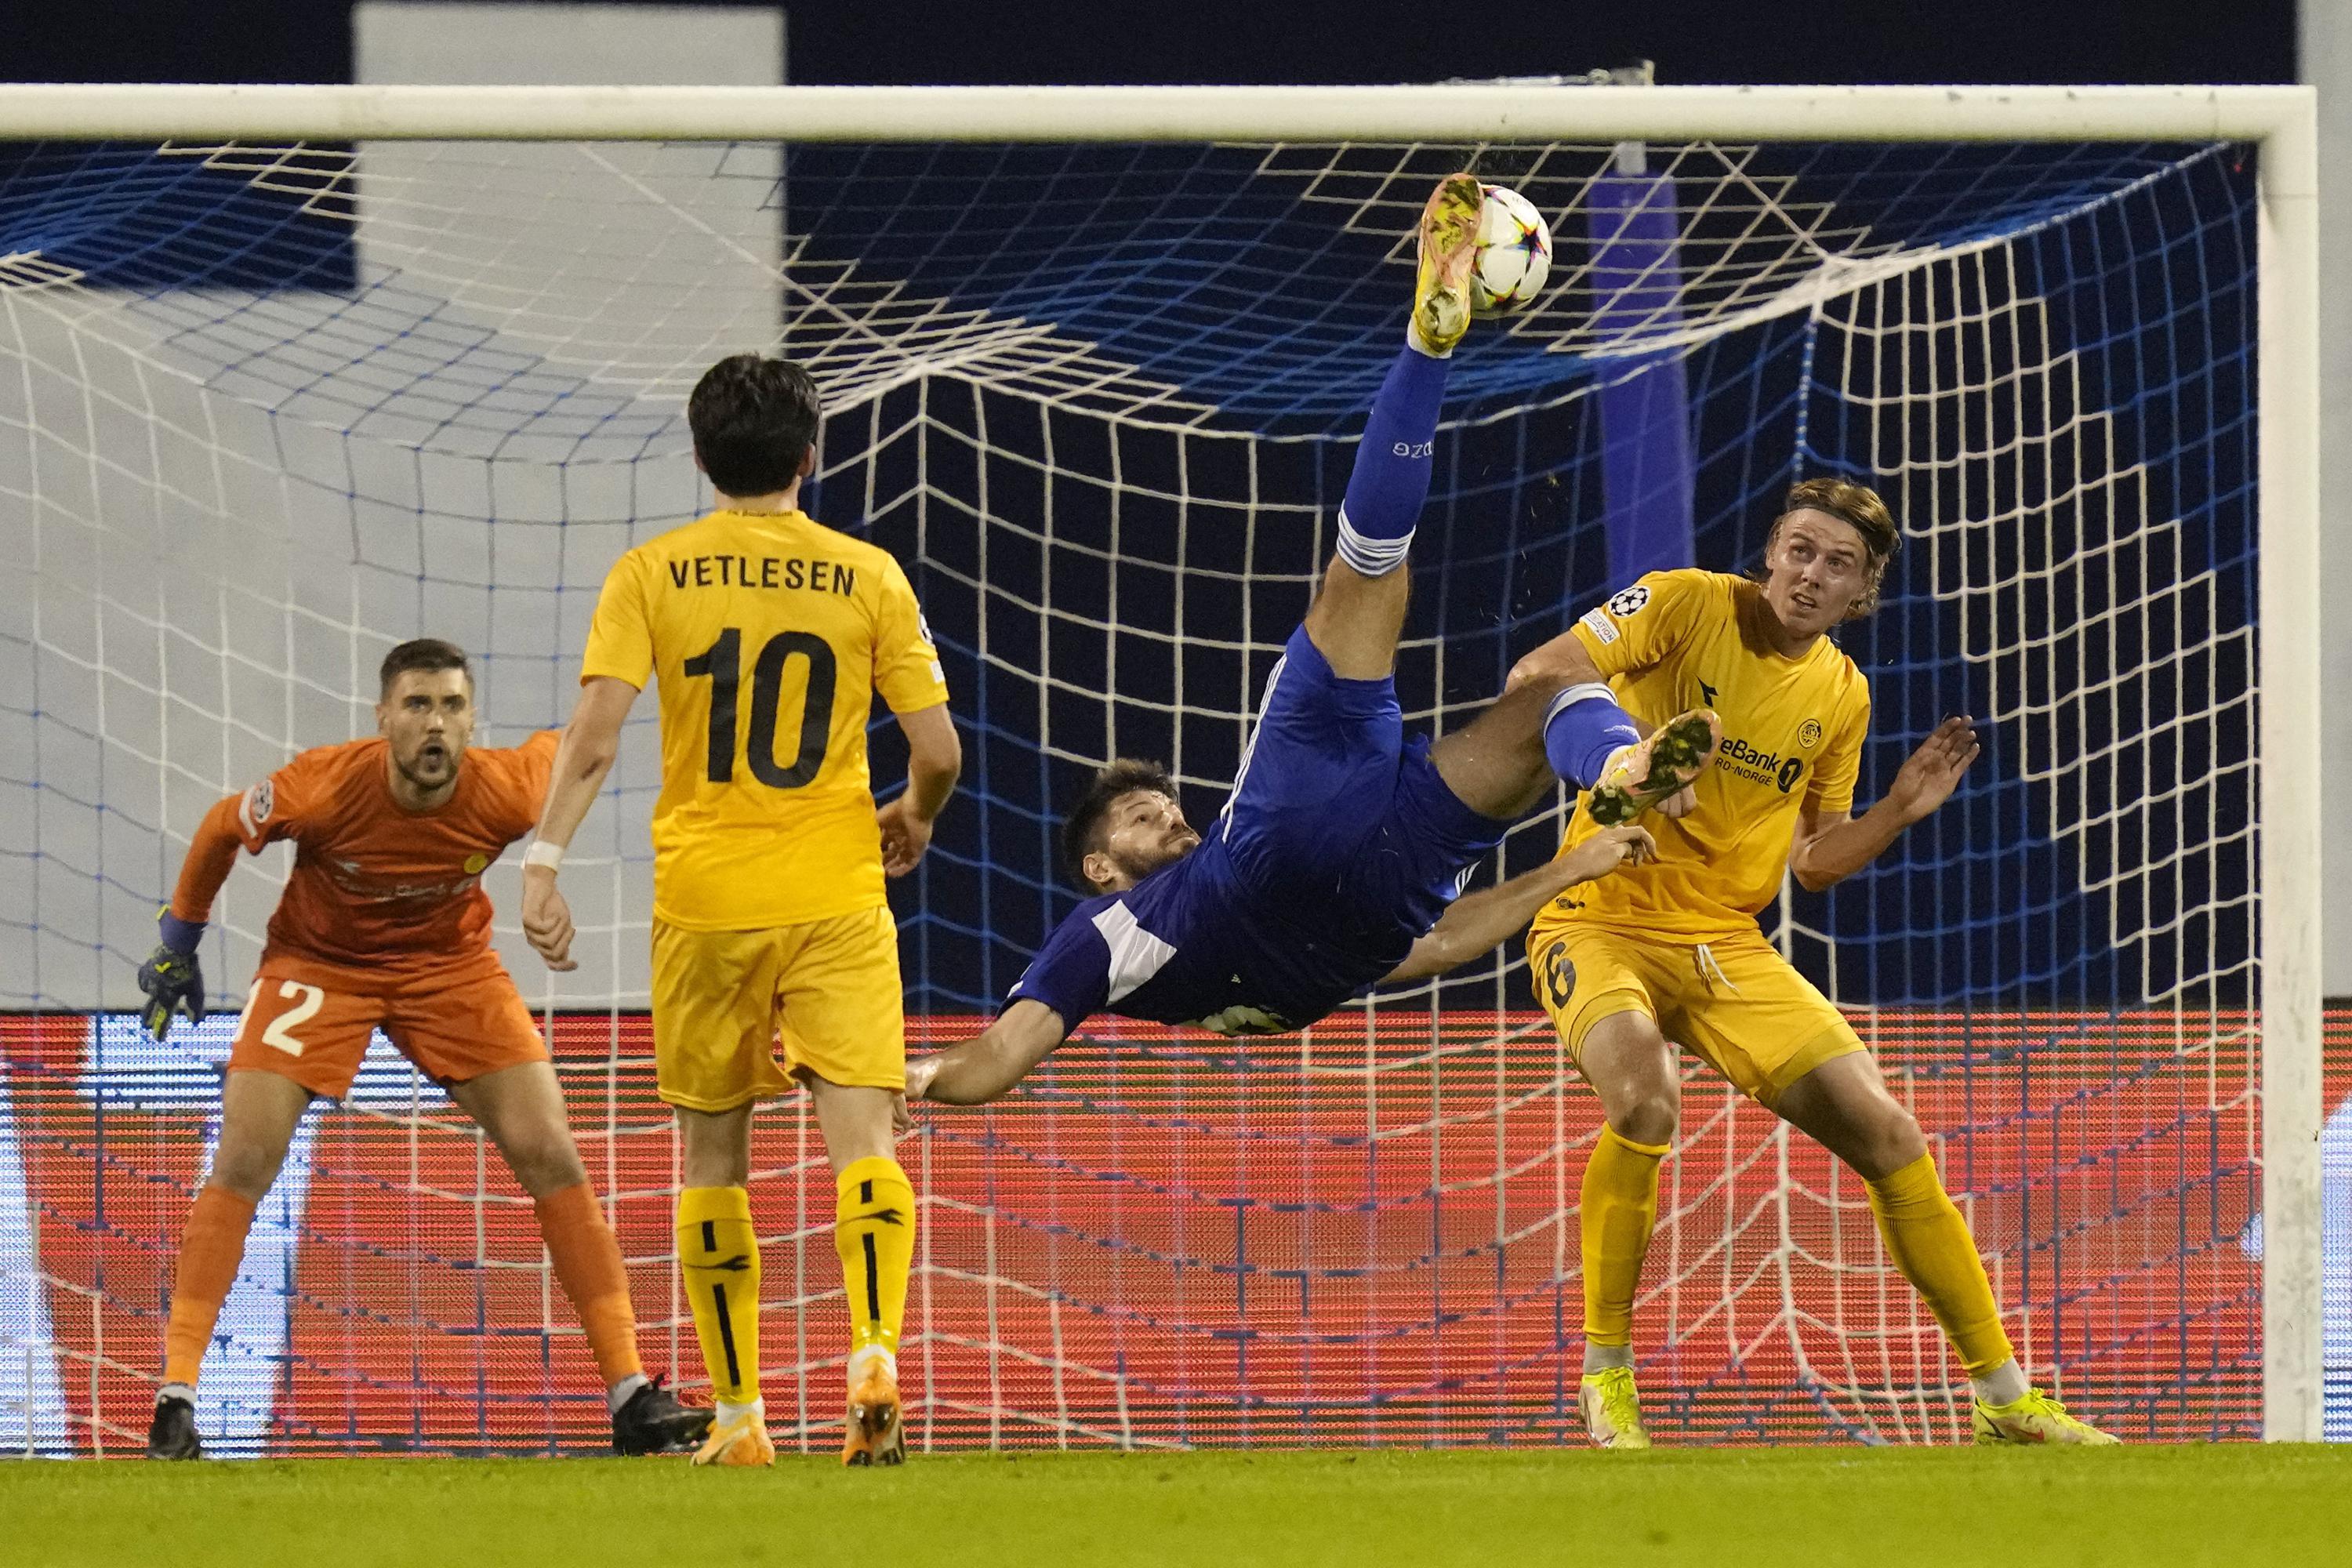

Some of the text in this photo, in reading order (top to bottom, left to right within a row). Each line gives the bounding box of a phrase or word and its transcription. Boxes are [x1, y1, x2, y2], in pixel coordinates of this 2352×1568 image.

[669, 555, 855, 597] VETLESEN
[684, 626, 837, 789] 10
[1715, 757, 1773, 787] RD-NORGE
[1720, 736, 1782, 773] eBank
[1546, 941, 1576, 1011] 6
